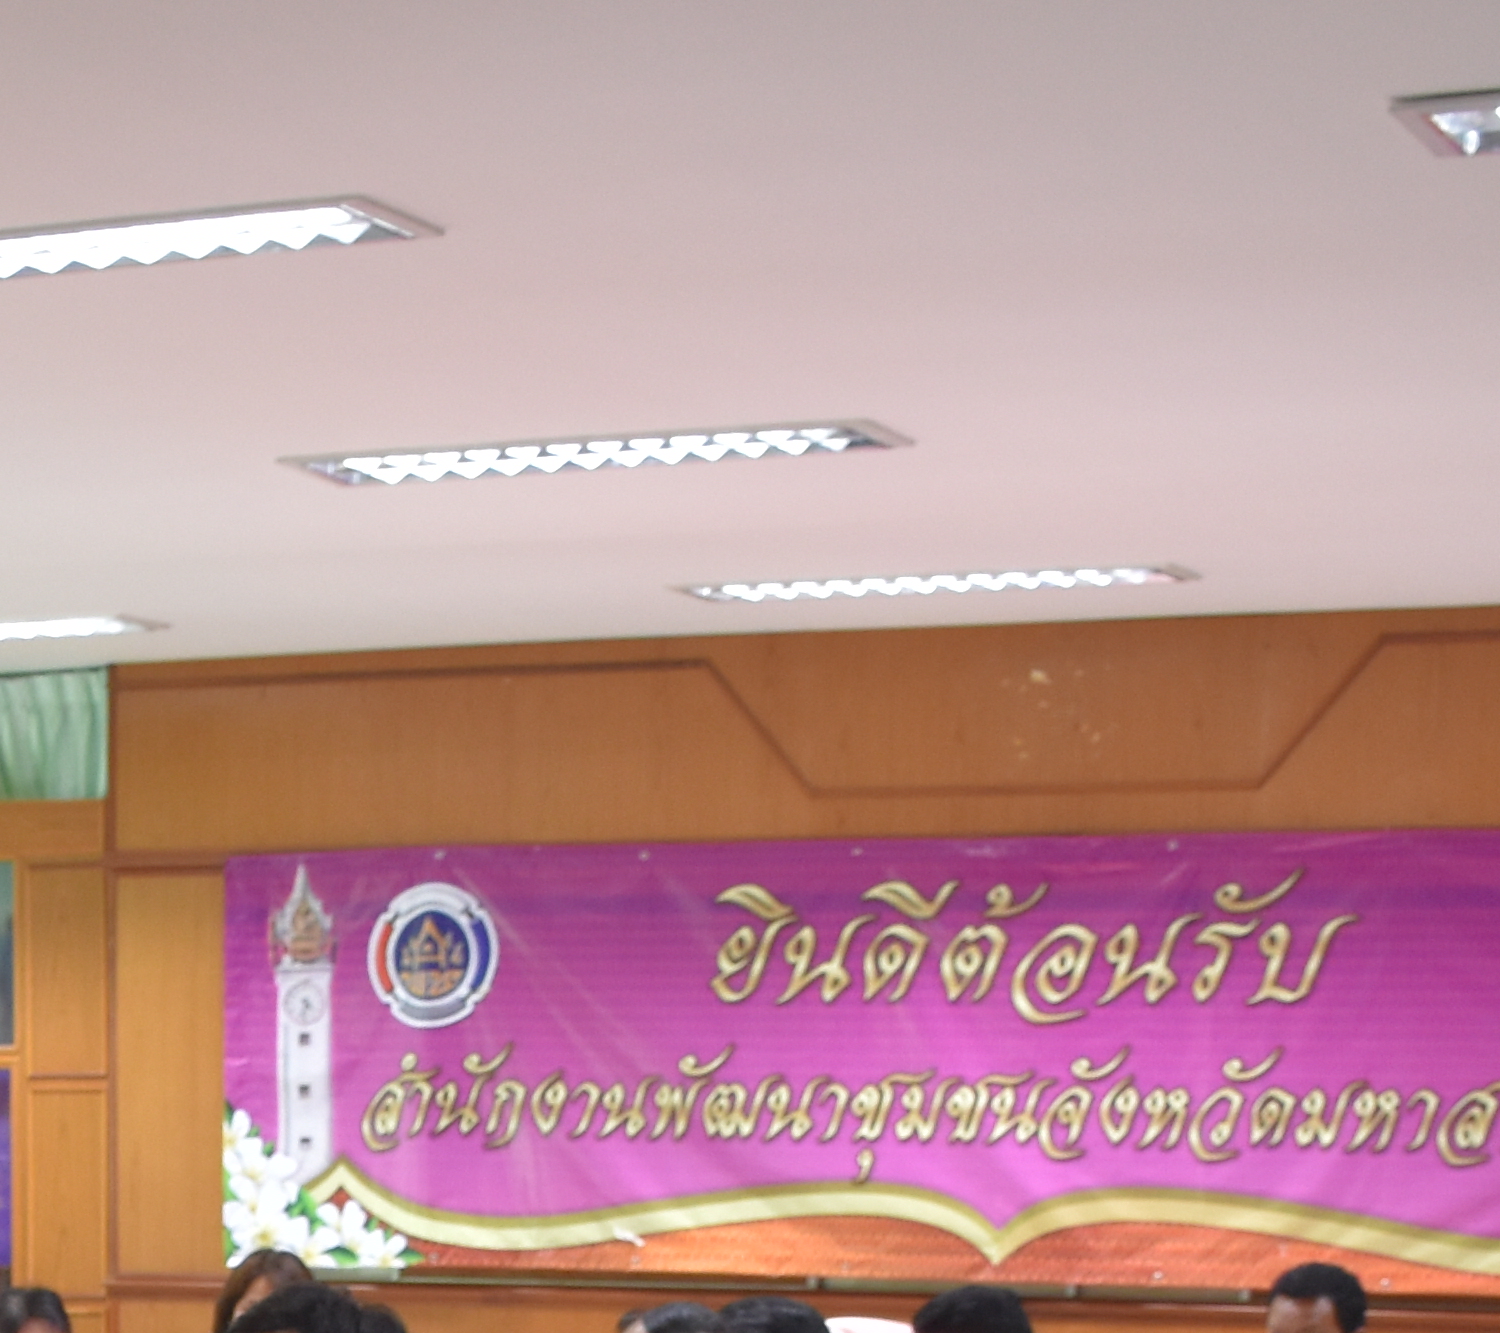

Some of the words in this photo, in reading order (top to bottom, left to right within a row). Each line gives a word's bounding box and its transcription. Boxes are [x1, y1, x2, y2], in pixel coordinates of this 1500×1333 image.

[709, 868, 1360, 1027] ยินดีต้อนรับ
